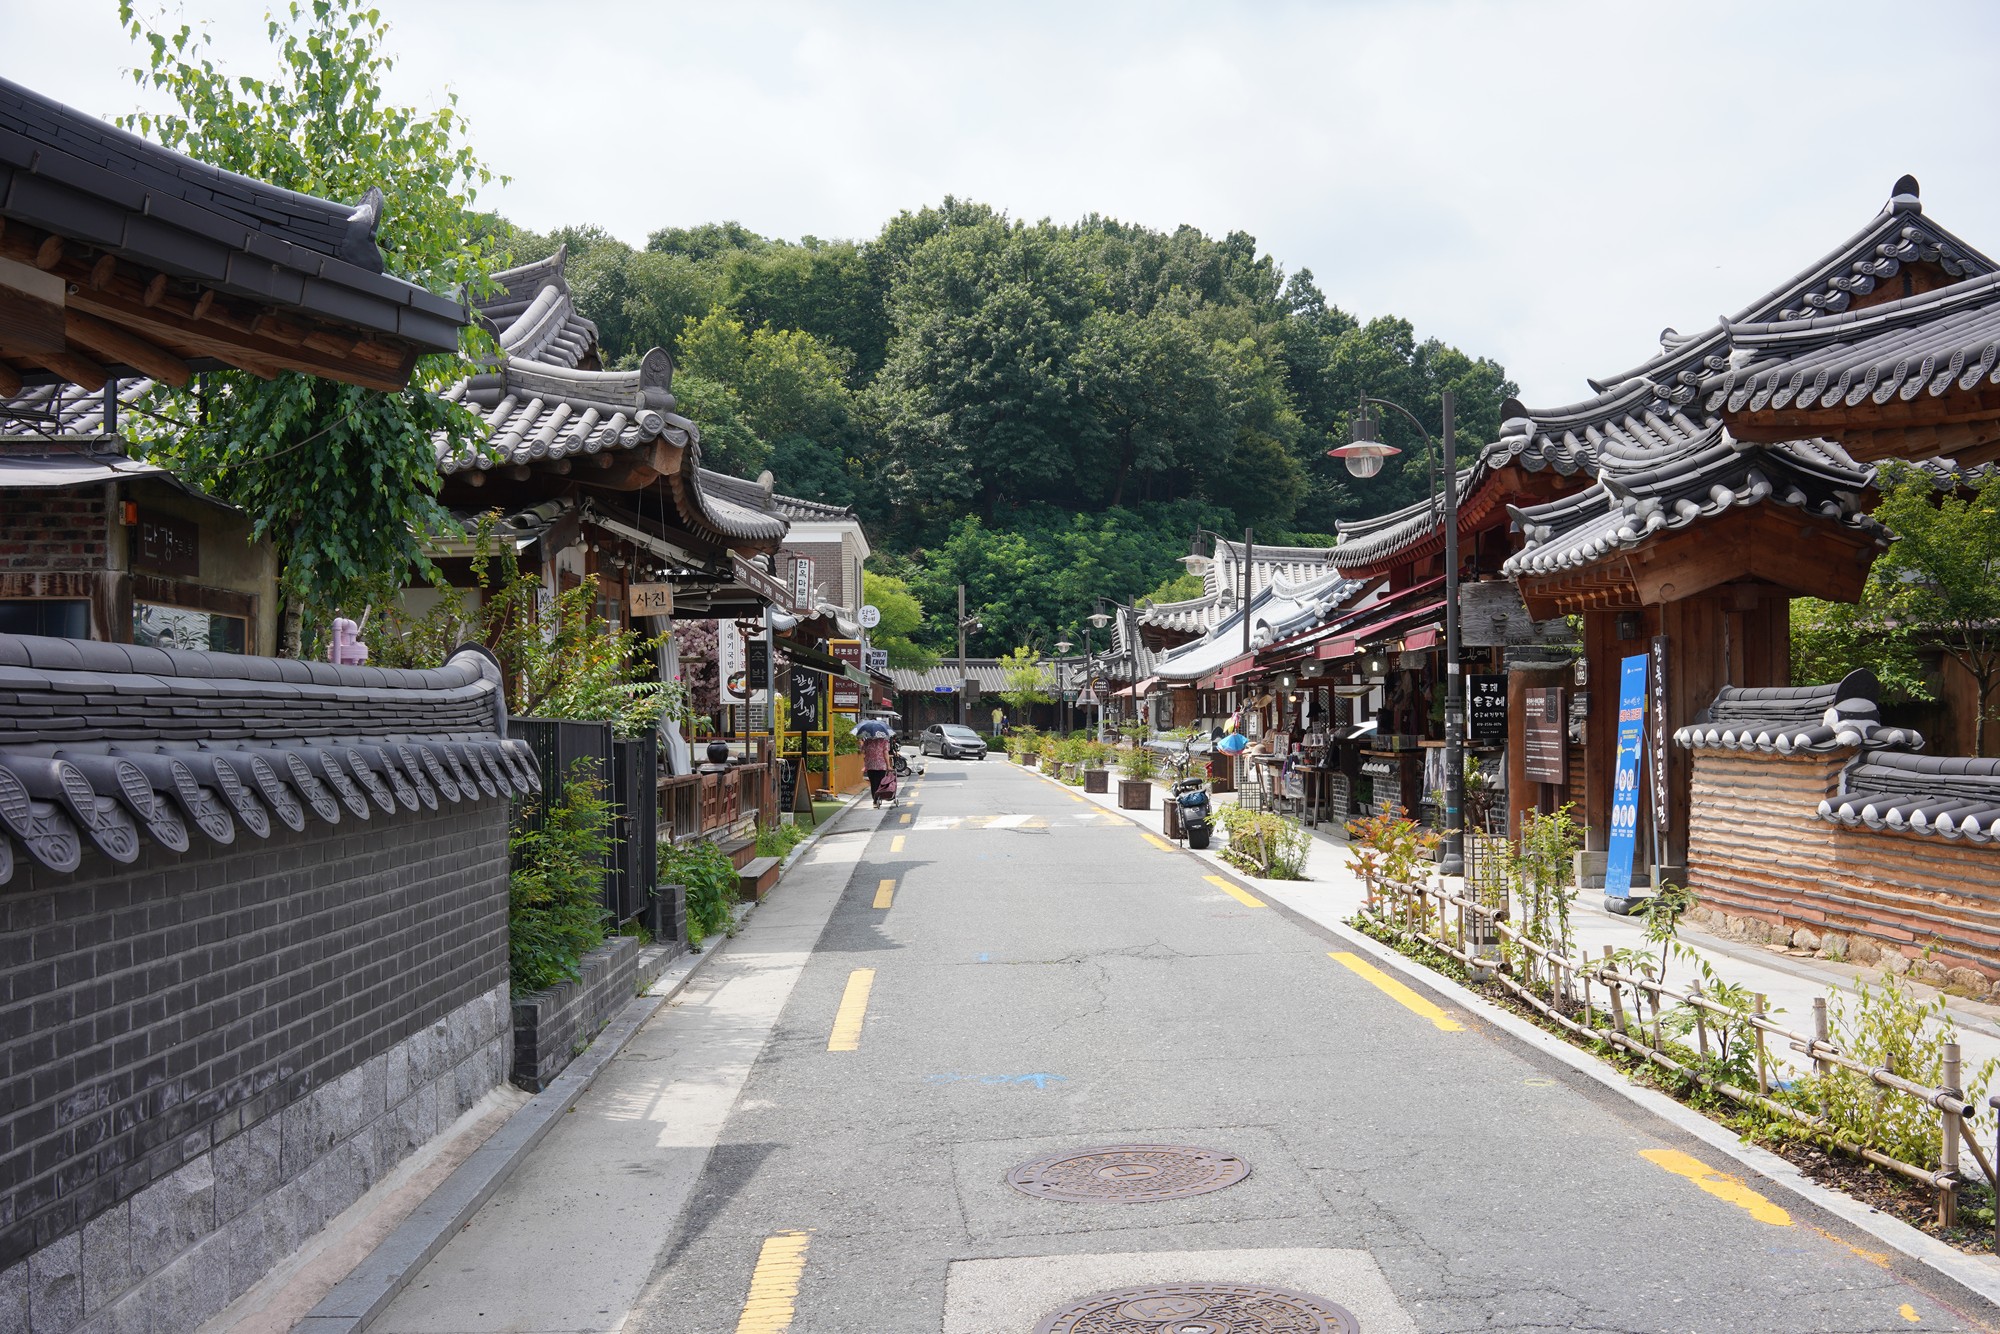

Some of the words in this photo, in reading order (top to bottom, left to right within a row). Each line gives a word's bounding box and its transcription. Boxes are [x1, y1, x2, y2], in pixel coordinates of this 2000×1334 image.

[797, 560, 807, 596] 한옥마루
[635, 591, 666, 607] 사진
[727, 622, 735, 669] 시래기국밥
[752, 651, 766, 679] 숙박
